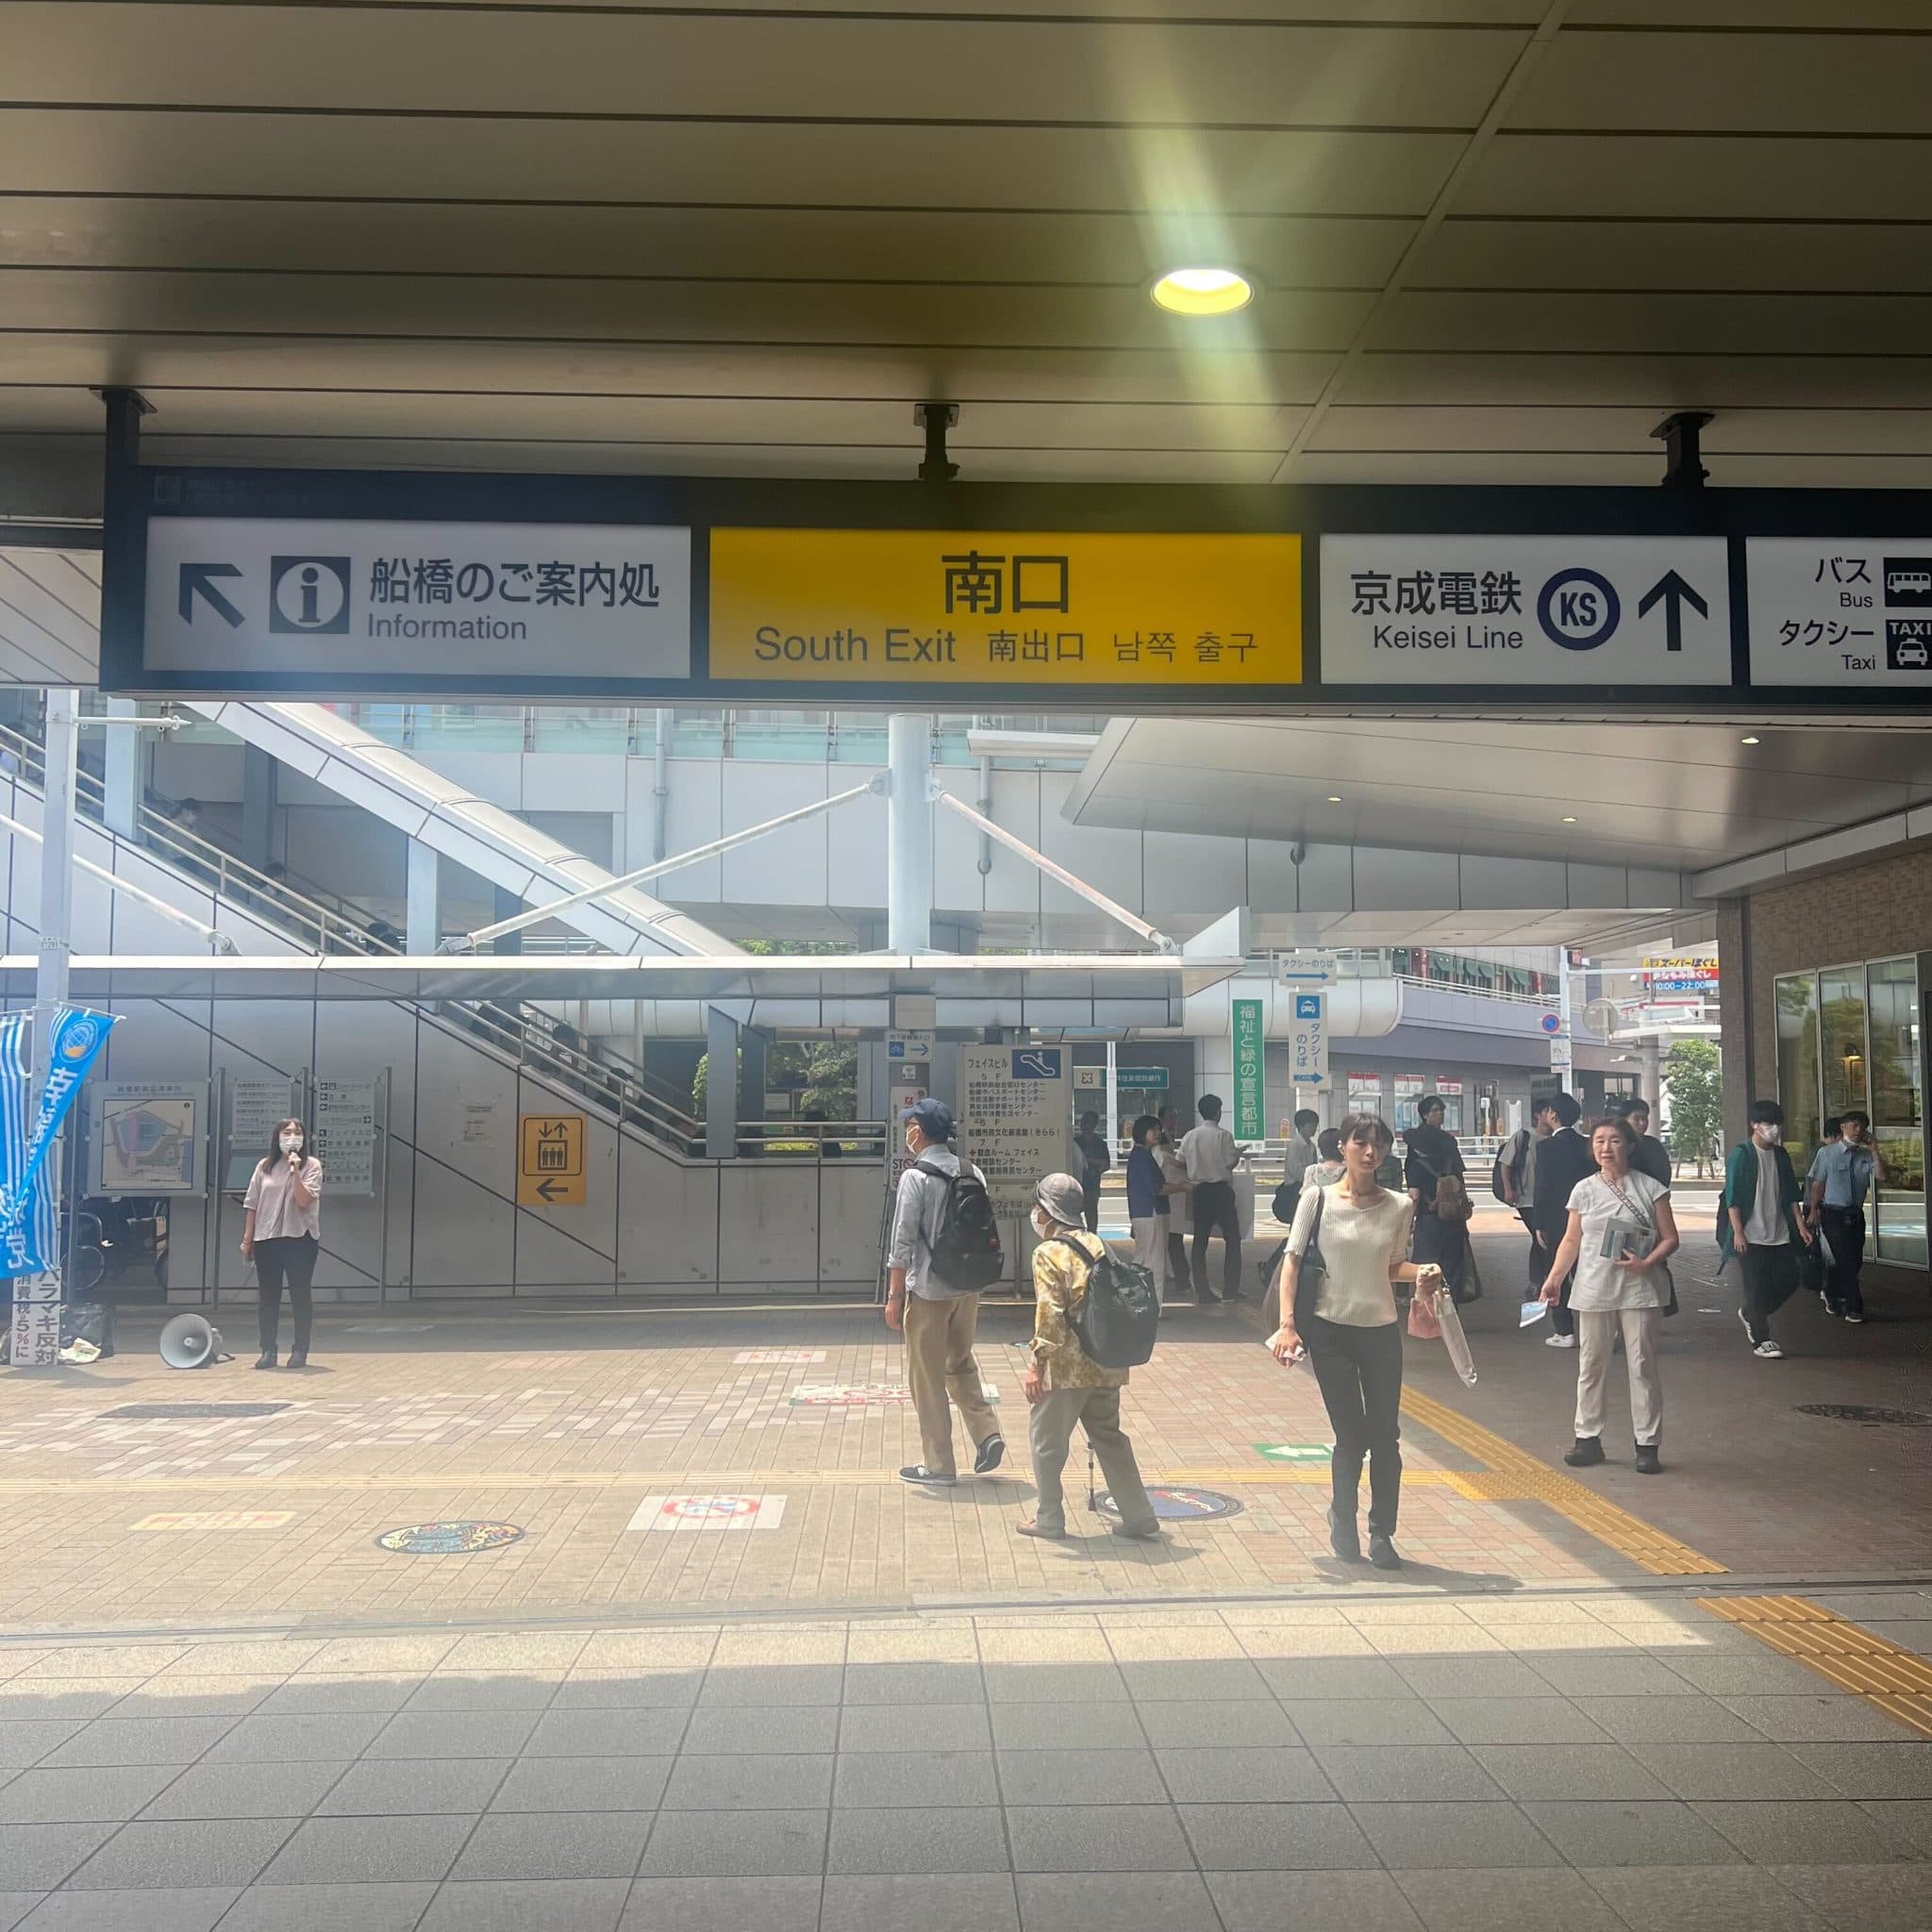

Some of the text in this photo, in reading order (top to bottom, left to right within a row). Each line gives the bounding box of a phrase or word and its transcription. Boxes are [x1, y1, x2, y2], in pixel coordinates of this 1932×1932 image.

[369, 558, 659, 608] 船橋のご案内処
[941, 551, 1069, 614] 南口
[1815, 557, 1872, 584] バス
[1351, 571, 1523, 616] 京成電鉄
[1559, 591, 1598, 626] KS
[1840, 592, 1874, 608] Bus
[368, 612, 526, 641] Information
[1374, 625, 1524, 649] Keisei Line
[1779, 620, 1874, 646] タクシー
[1890, 623, 1932, 635] TAXI
[755, 626, 956, 662] South Exit
[987, 630, 1084, 662] 南出口
[1113, 632, 1258, 663] 남쪽 출구
[1841, 655, 1876, 670] Taxi
[1282, 958, 1334, 968] タクシーのりば
[1296, 1034, 1307, 1067] のりば
[1310, 1023, 1321, 1068] タクシー
[968, 1058, 1008, 1069] フェイスビル
[1239, 1006, 1258, 1136] 福祉と緑の宣言都市
[35, 1268, 60, 1365] バラマキ反対
